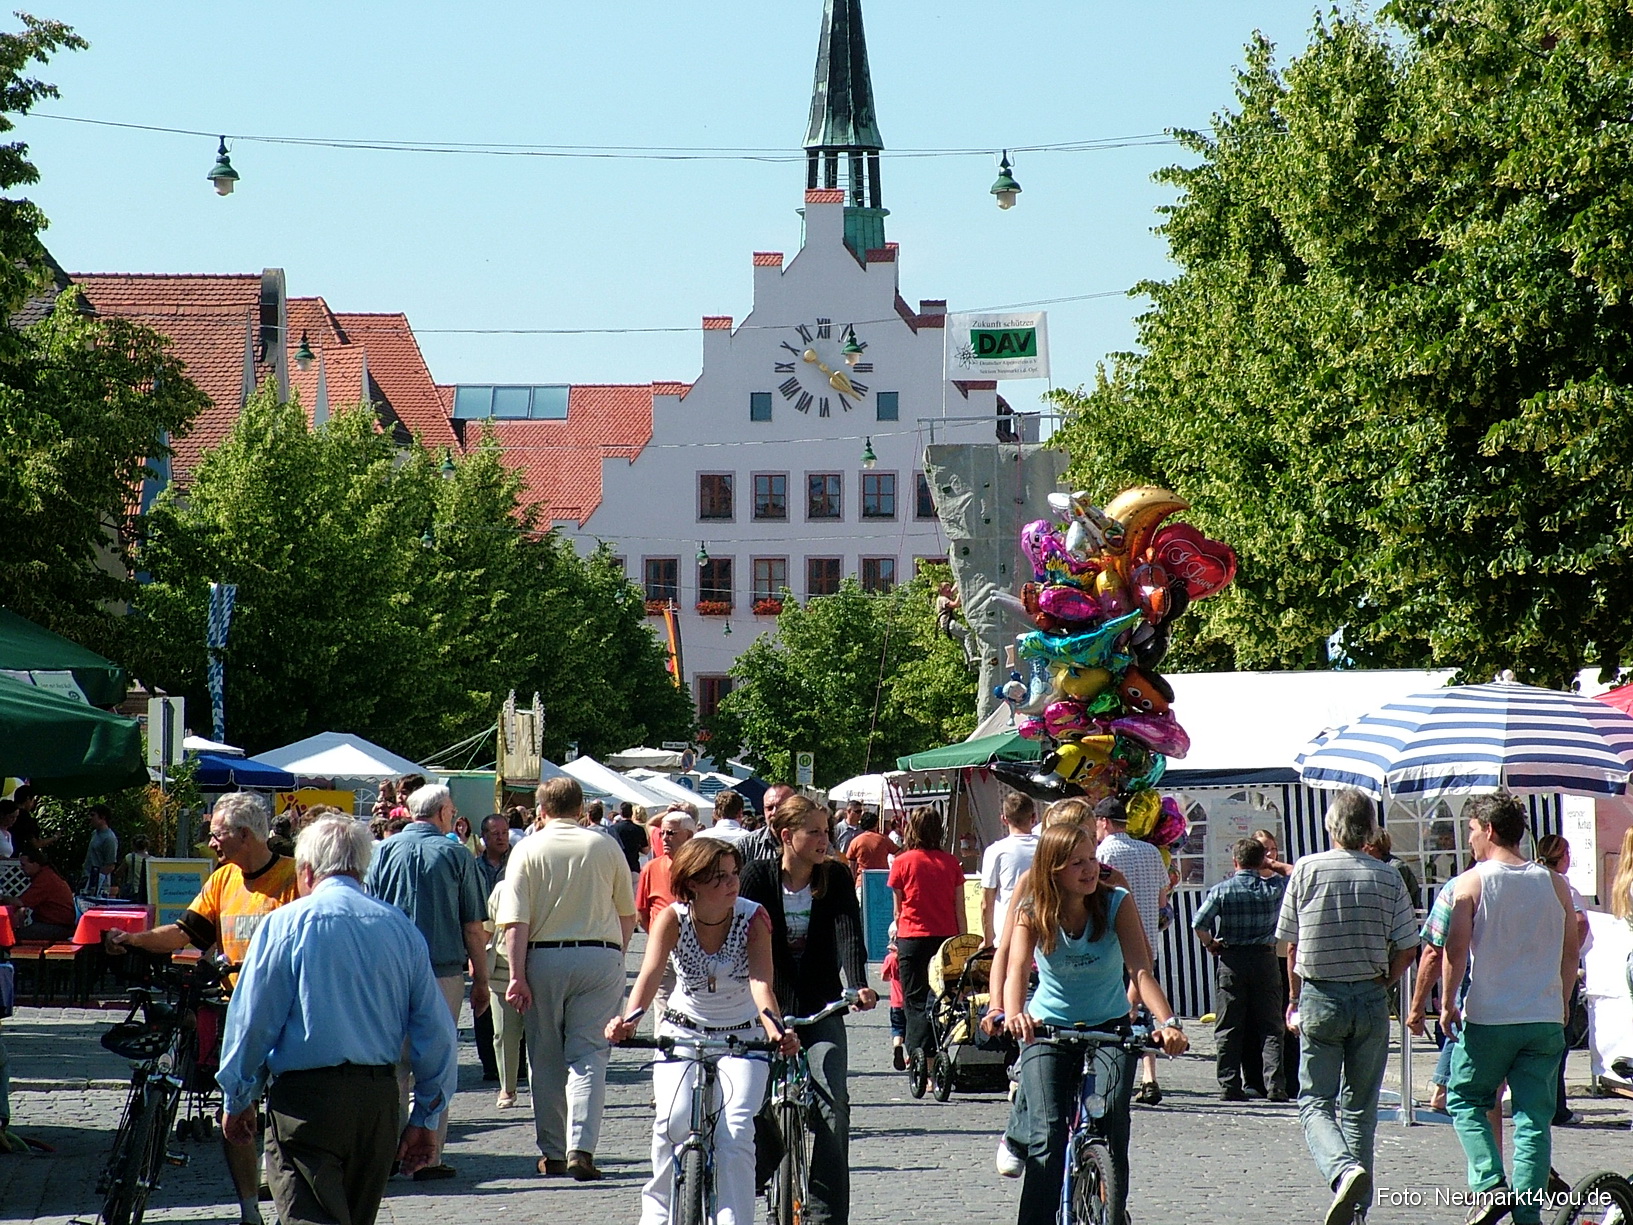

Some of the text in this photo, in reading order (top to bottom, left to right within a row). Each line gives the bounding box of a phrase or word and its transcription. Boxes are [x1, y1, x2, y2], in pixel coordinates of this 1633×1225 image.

[972, 319, 1034, 328] Zukunft schützen
[978, 331, 1031, 354] DAV
[1181, 561, 1214, 589] Love
